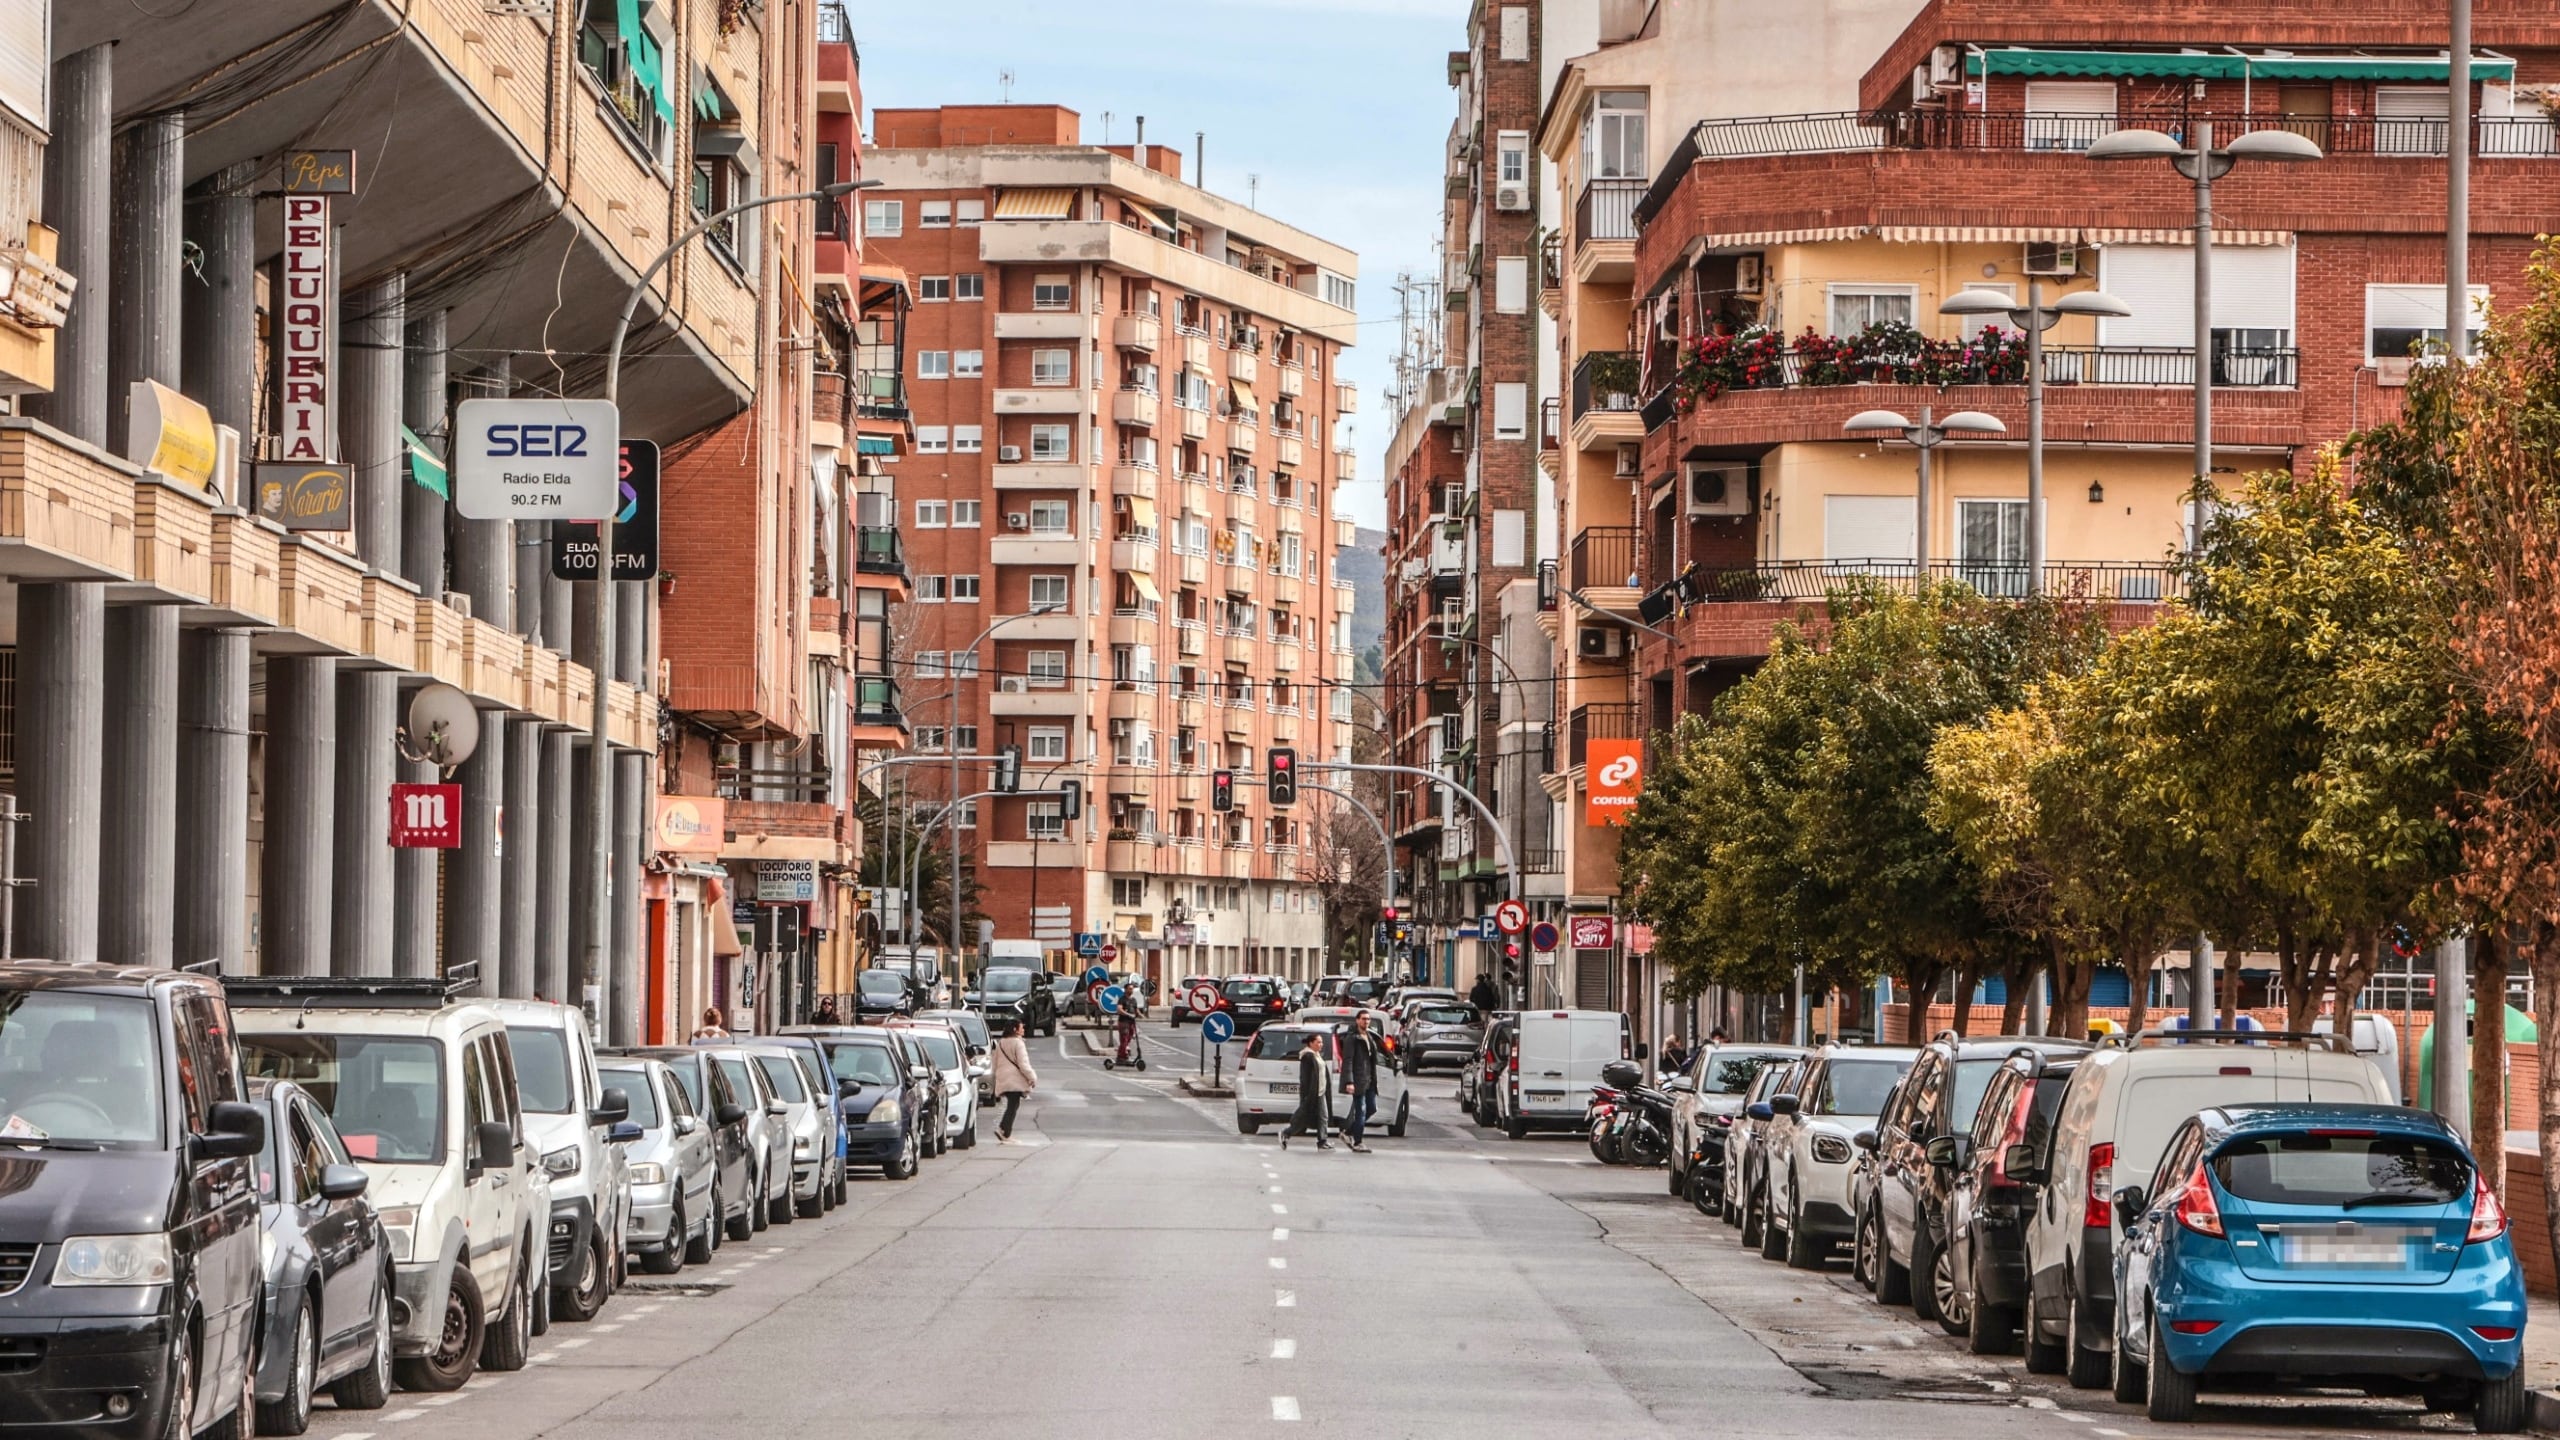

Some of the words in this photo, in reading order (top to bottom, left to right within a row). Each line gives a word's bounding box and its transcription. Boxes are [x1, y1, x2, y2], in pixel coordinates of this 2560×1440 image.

[287, 153, 345, 192] Pepe
[287, 199, 322, 458] PELUQUERIA
[487, 425, 587, 457] SER
[503, 473, 540, 484] Radio
[543, 473, 571, 484] Elda
[511, 494, 538, 506] 90.2
[541, 494, 562, 506] FM
[566, 543, 600, 553] ELDA
[1591, 796, 1636, 805] consu
[403, 794, 449, 828] m
[760, 862, 812, 871] LOCUTORIO
[760, 873, 812, 881] TELEFONICO
[1483, 919, 1495, 938] P
[1574, 929, 1606, 946] Sany
